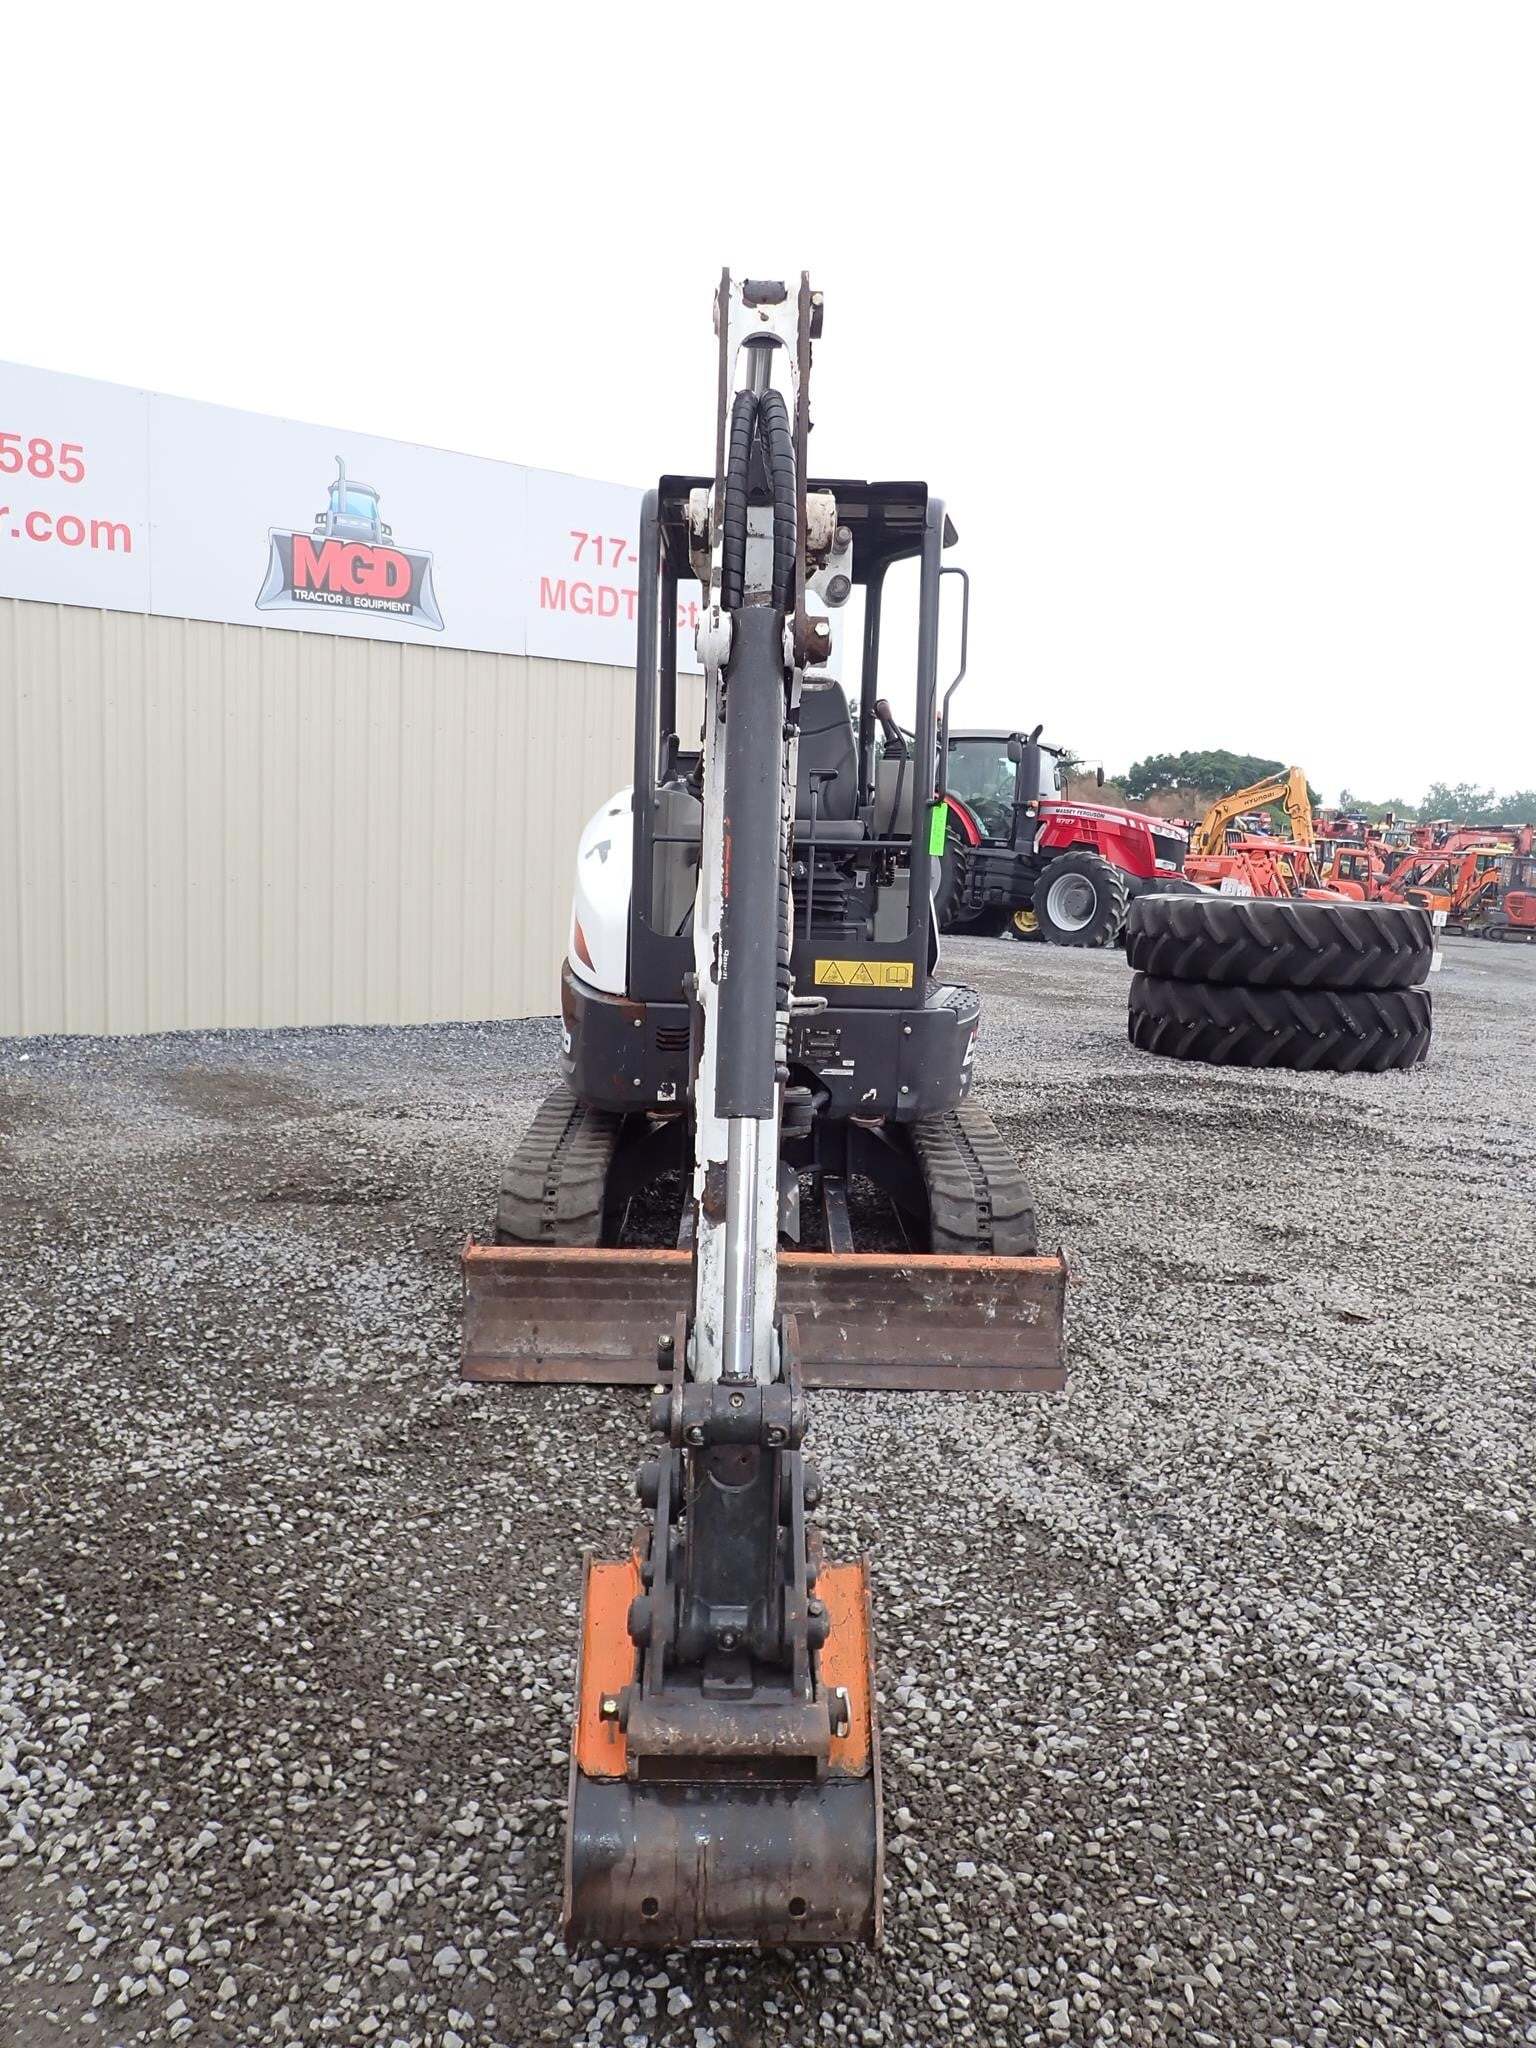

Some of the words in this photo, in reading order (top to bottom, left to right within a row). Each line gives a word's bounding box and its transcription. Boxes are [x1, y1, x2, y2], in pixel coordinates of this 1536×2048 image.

[292, 534, 412, 599] MGD
[294, 589, 343, 605] TRACTOR
[354, 597, 411, 613] EQUIPMENT
[1244, 792, 1275, 806] HYUNDAI
[1077, 809, 1105, 818] FERGUSON
